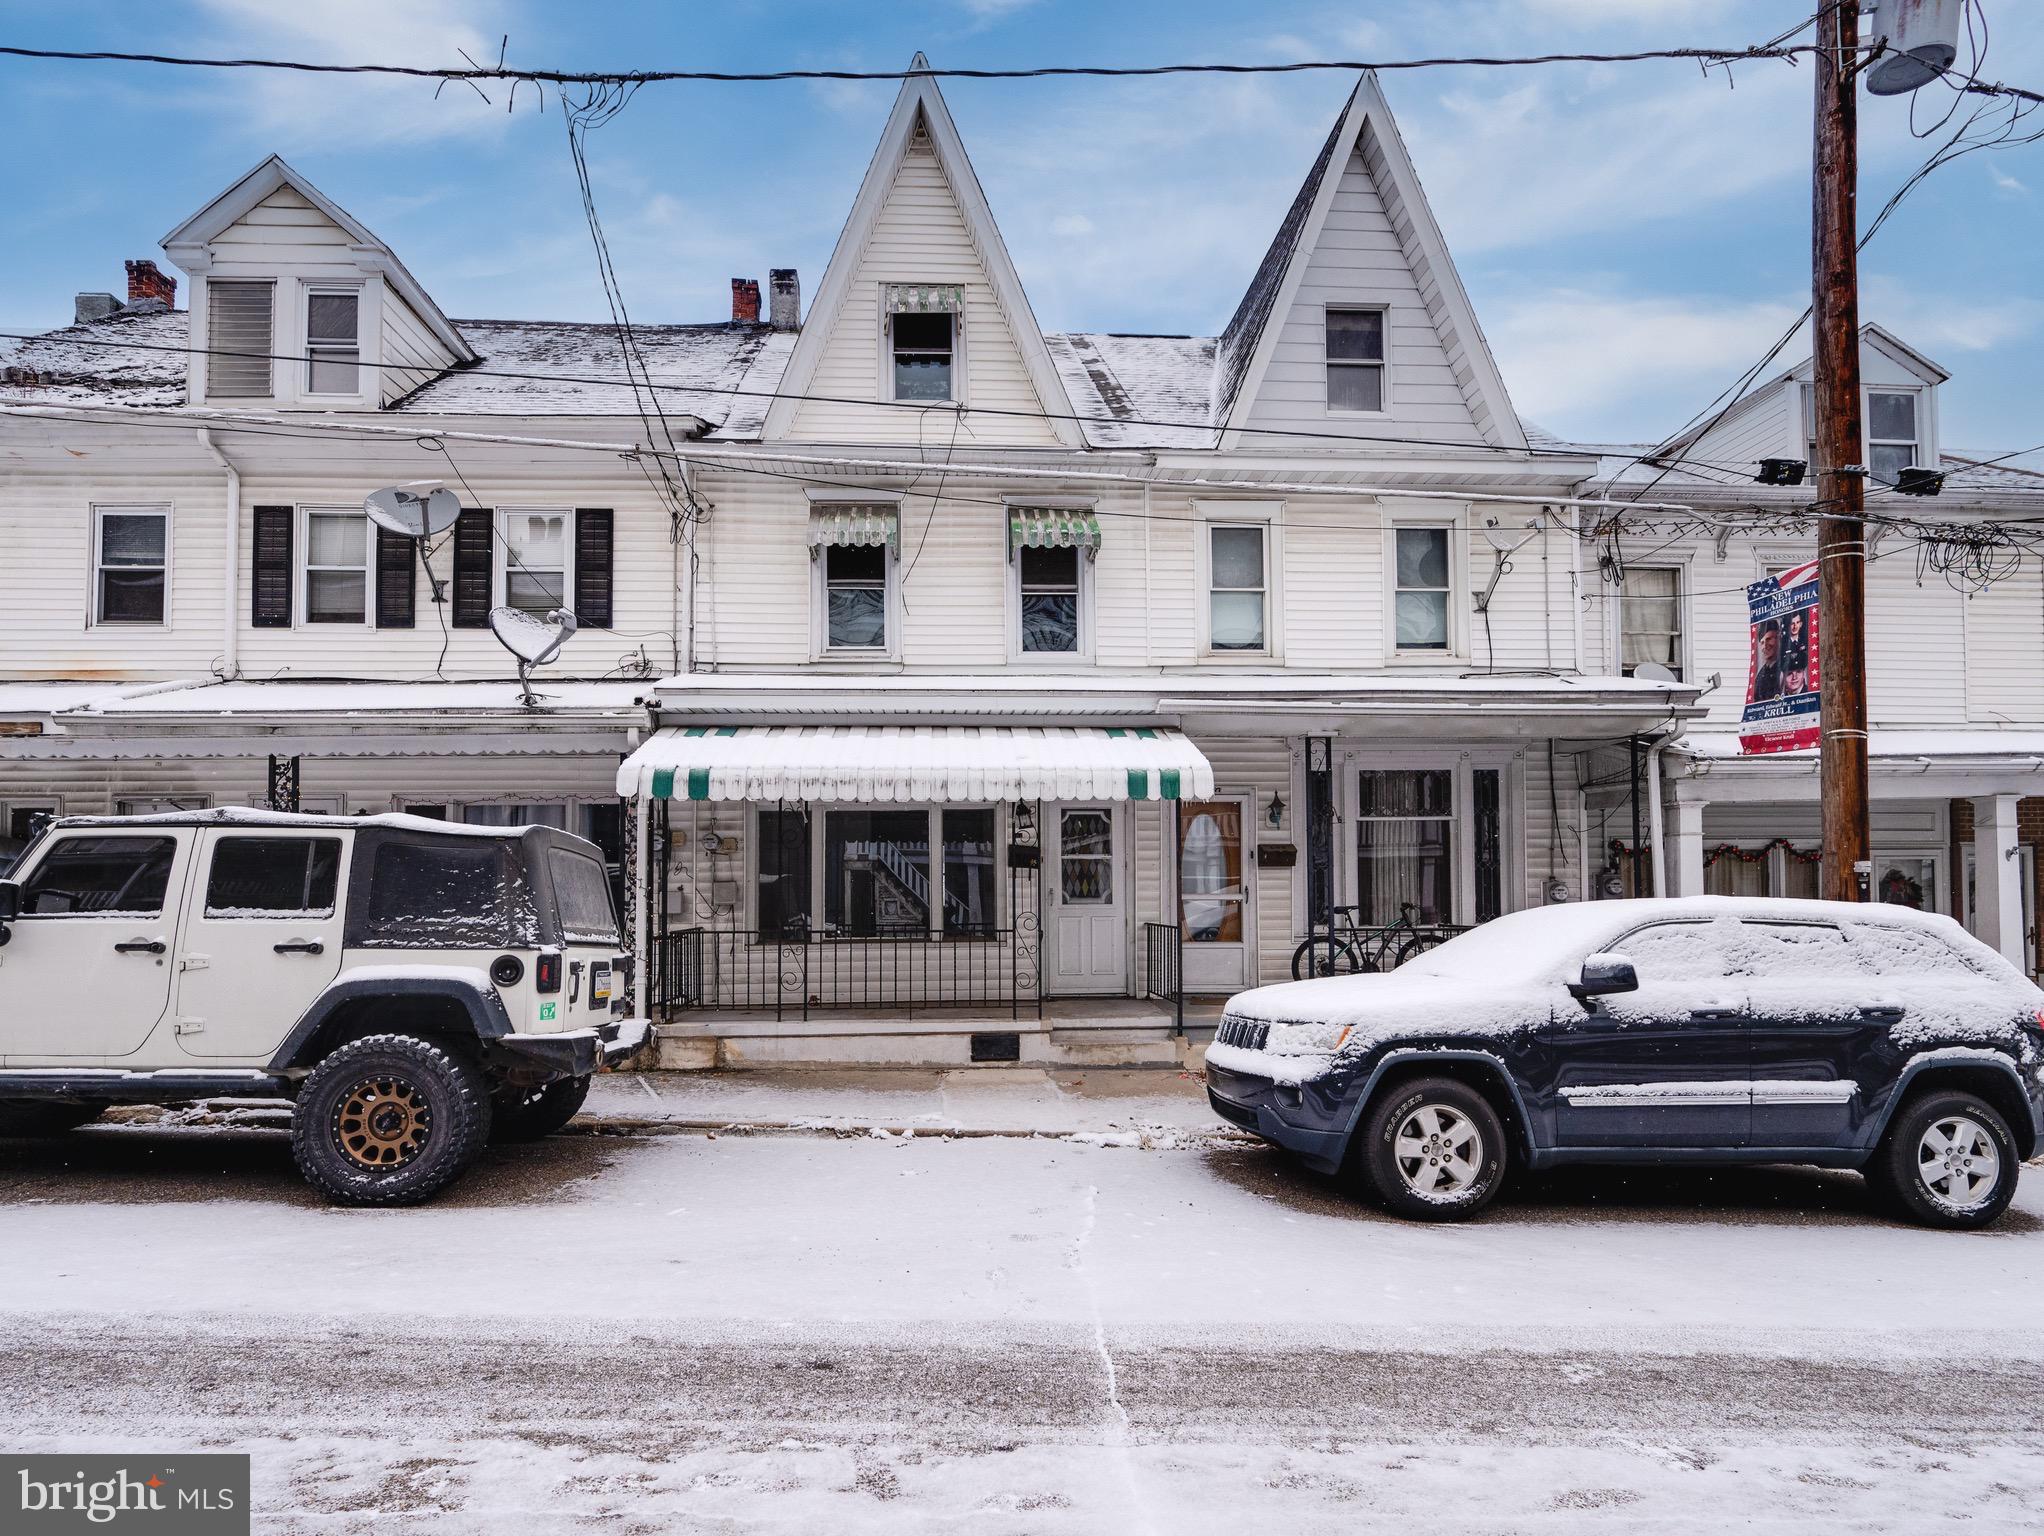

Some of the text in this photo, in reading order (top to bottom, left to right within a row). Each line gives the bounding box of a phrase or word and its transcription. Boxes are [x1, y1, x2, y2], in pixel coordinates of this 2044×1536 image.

[1771, 589, 1792, 602] NEW
[1750, 590, 1818, 617] PHILADELPHIA
[1770, 604, 1794, 615] HONORS
[1764, 706, 1795, 718] KRULL
